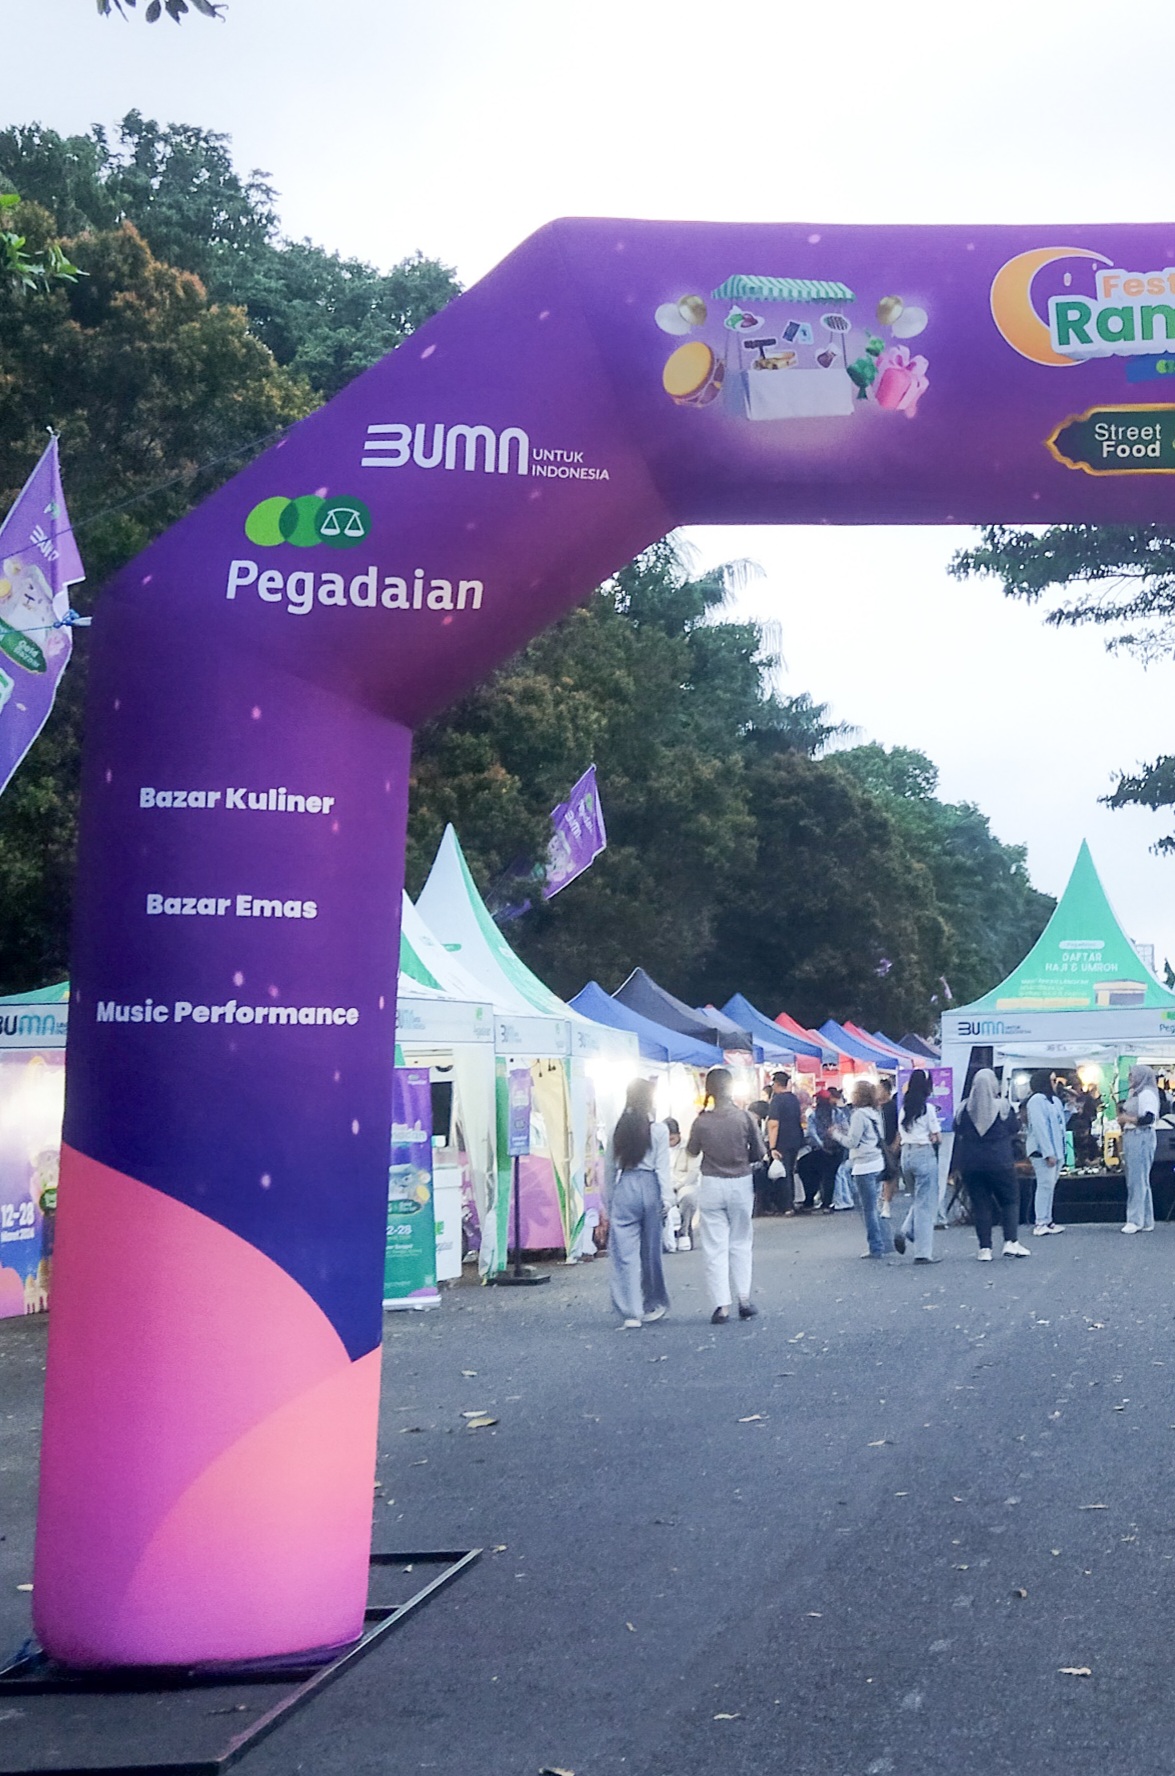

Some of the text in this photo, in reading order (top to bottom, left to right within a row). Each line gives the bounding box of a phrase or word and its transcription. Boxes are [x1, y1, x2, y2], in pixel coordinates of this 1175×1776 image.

[1094, 423, 1161, 440] Street
[361, 423, 530, 475] BUMN
[532, 448, 584, 463] UNTUK
[1102, 440, 1161, 458] Food
[531, 464, 610, 481] INDONESIA
[226, 560, 484, 614] Pegadaian
[140, 786, 334, 814] Bazar Kuliner
[146, 893, 318, 919] Bazar Emas
[1062, 952, 1102, 961] DAFTAR
[1081, 962, 1118, 972] UMROH
[96, 998, 360, 1027] Music Performance
[958, 1021, 1004, 1035] BUMN
